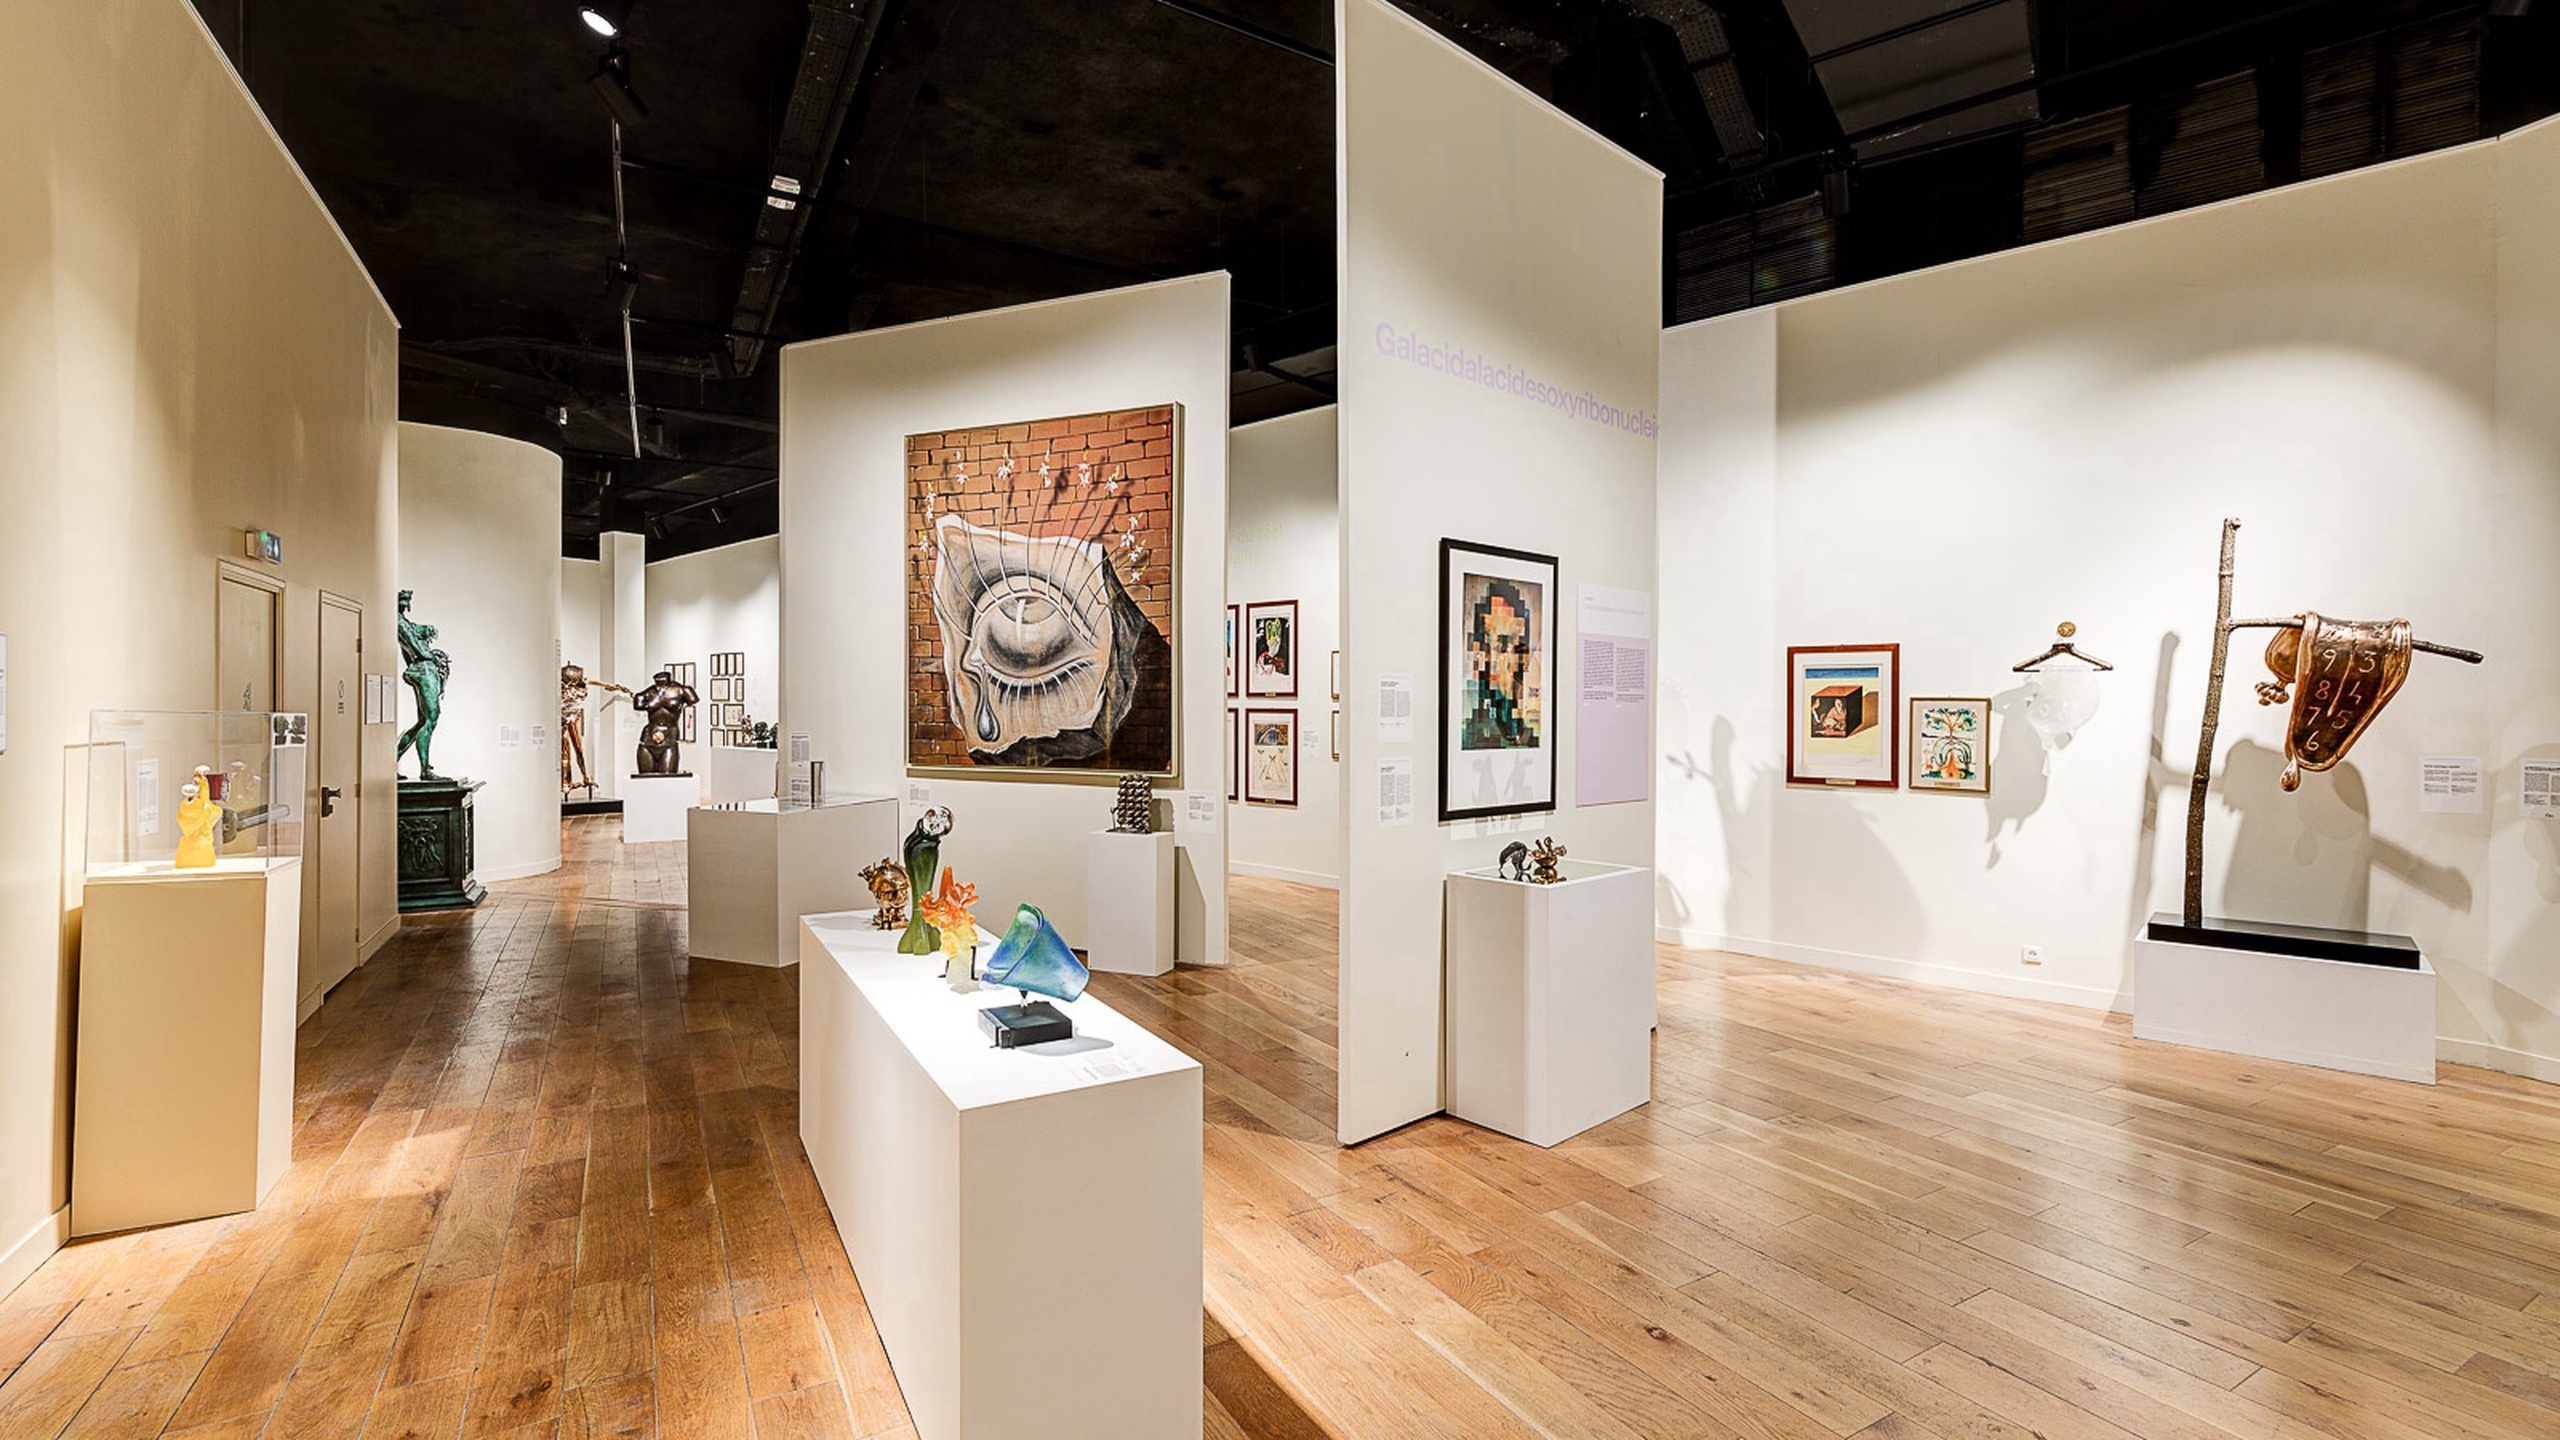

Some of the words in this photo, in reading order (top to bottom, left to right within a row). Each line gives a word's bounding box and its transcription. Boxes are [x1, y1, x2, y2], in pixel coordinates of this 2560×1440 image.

[2322, 649, 2337, 672] 9
[2358, 650, 2376, 673] 3
[2315, 679, 2331, 700] 8
[2348, 681, 2362, 704] 4
[2308, 706, 2321, 726] 7
[2331, 709, 2353, 729] 5
[2306, 730, 2319, 751] 6
